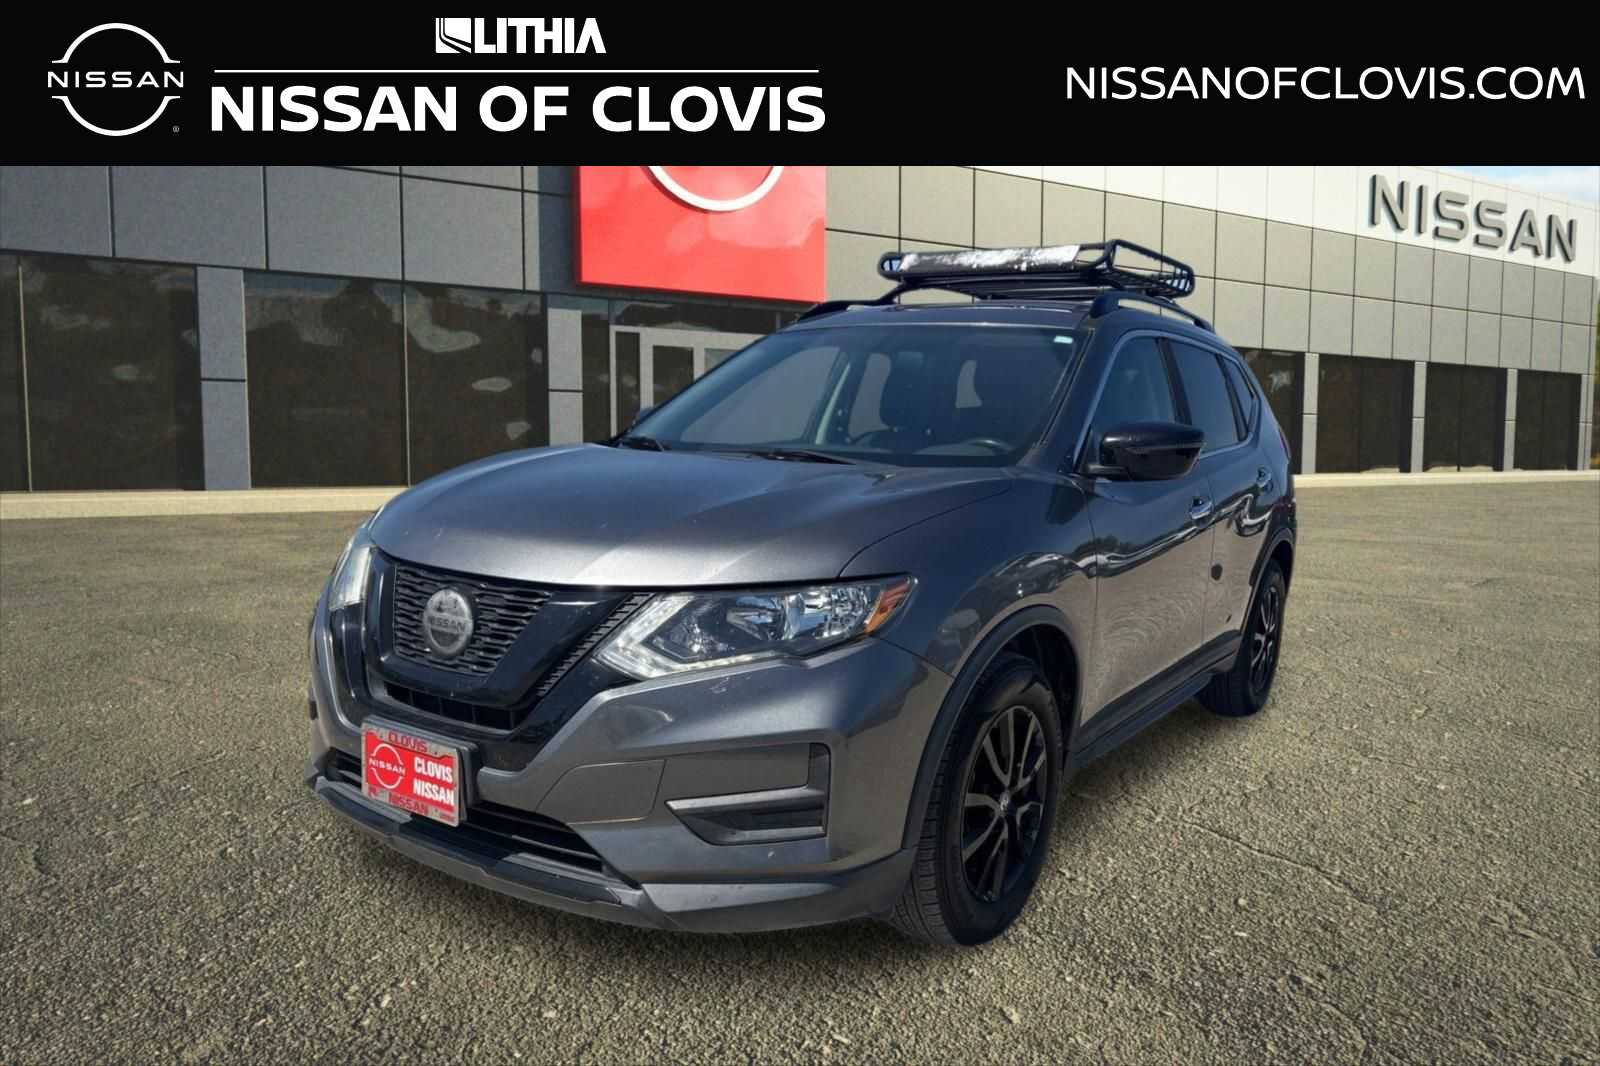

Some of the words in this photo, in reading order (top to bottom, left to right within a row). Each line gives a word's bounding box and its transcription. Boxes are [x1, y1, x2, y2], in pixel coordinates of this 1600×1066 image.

[1368, 174, 1577, 263] NISSAN
[428, 615, 465, 632] NISSAN
[388, 731, 428, 753] CLOVIS
[368, 758, 406, 776] NISSAN
[413, 756, 453, 784] CLOVIS
[413, 778, 455, 806] NISSAN
